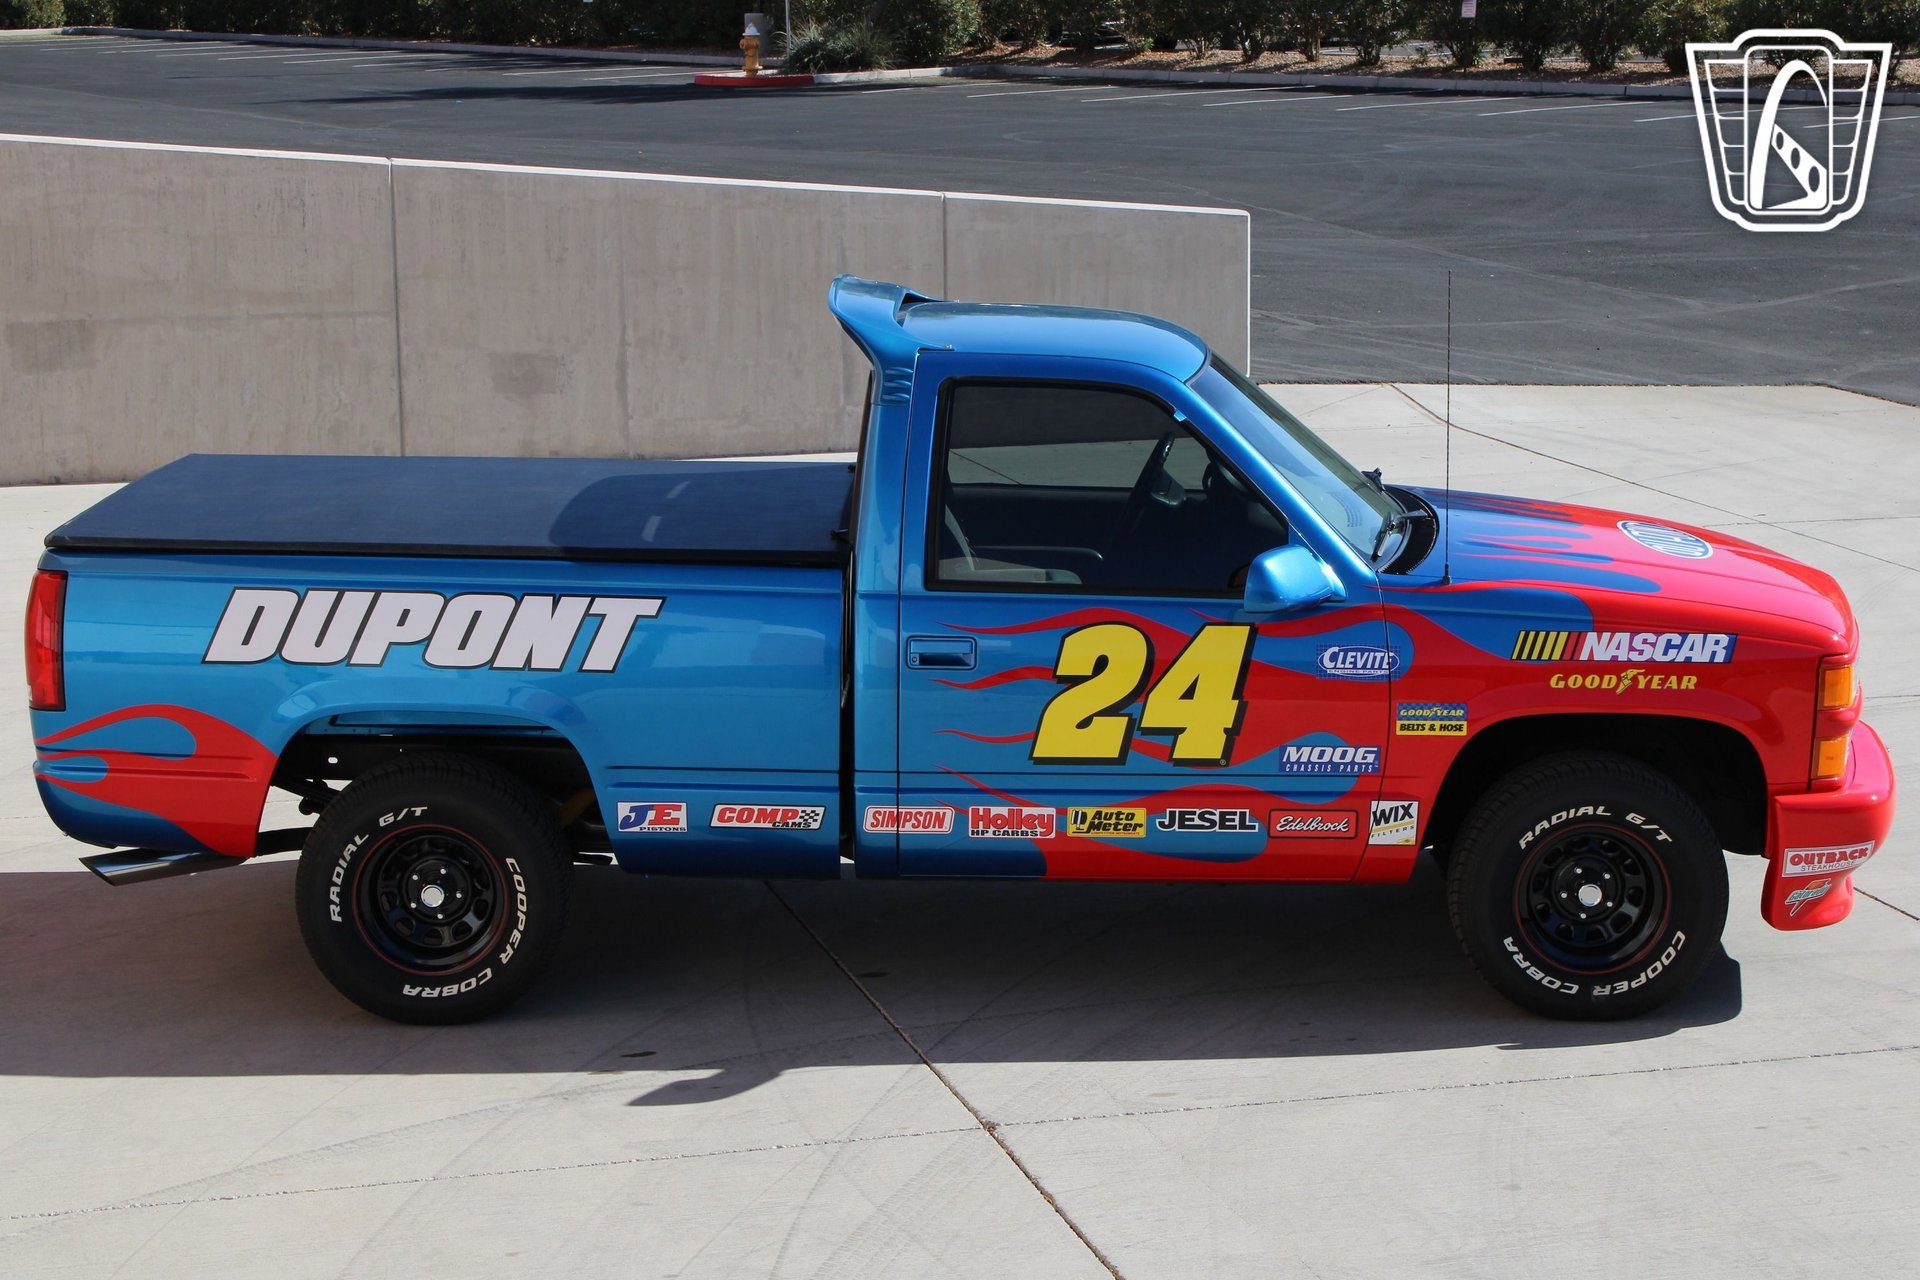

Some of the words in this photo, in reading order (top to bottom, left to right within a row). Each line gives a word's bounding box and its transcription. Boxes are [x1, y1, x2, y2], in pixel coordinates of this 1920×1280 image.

[202, 587, 667, 673] DUPONT
[1322, 646, 1394, 669] CLEVITE
[1579, 631, 1730, 663] NASCAR
[1029, 621, 1256, 765] 24
[1399, 723, 1426, 732] BELTS
[1428, 723, 1437, 732] &
[1439, 723, 1465, 732] HOSE
[1283, 746, 1378, 764] MOOG
[1285, 764, 1332, 773] CHASSIS
[1339, 764, 1373, 773] PARTS
[619, 804, 683, 831] JE
[716, 806, 800, 824] COMP
[771, 820, 812, 829] CAMS
[870, 809, 947, 830] SIMPSON
[970, 807, 1055, 837] Holley
[1091, 809, 1136, 822] Auto
[1156, 809, 1258, 832] JESEL
[1275, 815, 1350, 832] Edelbrock
[1372, 802, 1415, 827] WIX
[971, 829, 989, 837] HP
[992, 829, 1039, 837] CARBS
[1088, 820, 1144, 834] Meter
[1370, 824, 1415, 839] FILTERS
[1518, 805, 1612, 850] RADIAL
[1625, 812, 1673, 843] G/T
[330, 833, 369, 923] RADIAL
[378, 806, 428, 827] G/T
[1789, 847, 1869, 867] OUTBACK
[1800, 859, 1857, 872] STEAKHOUSE
[499, 857, 537, 965] COOPER
[1503, 936, 1580, 995] COBRA
[1592, 930, 1686, 996] COOPER
[402, 967, 493, 998] COBRA
